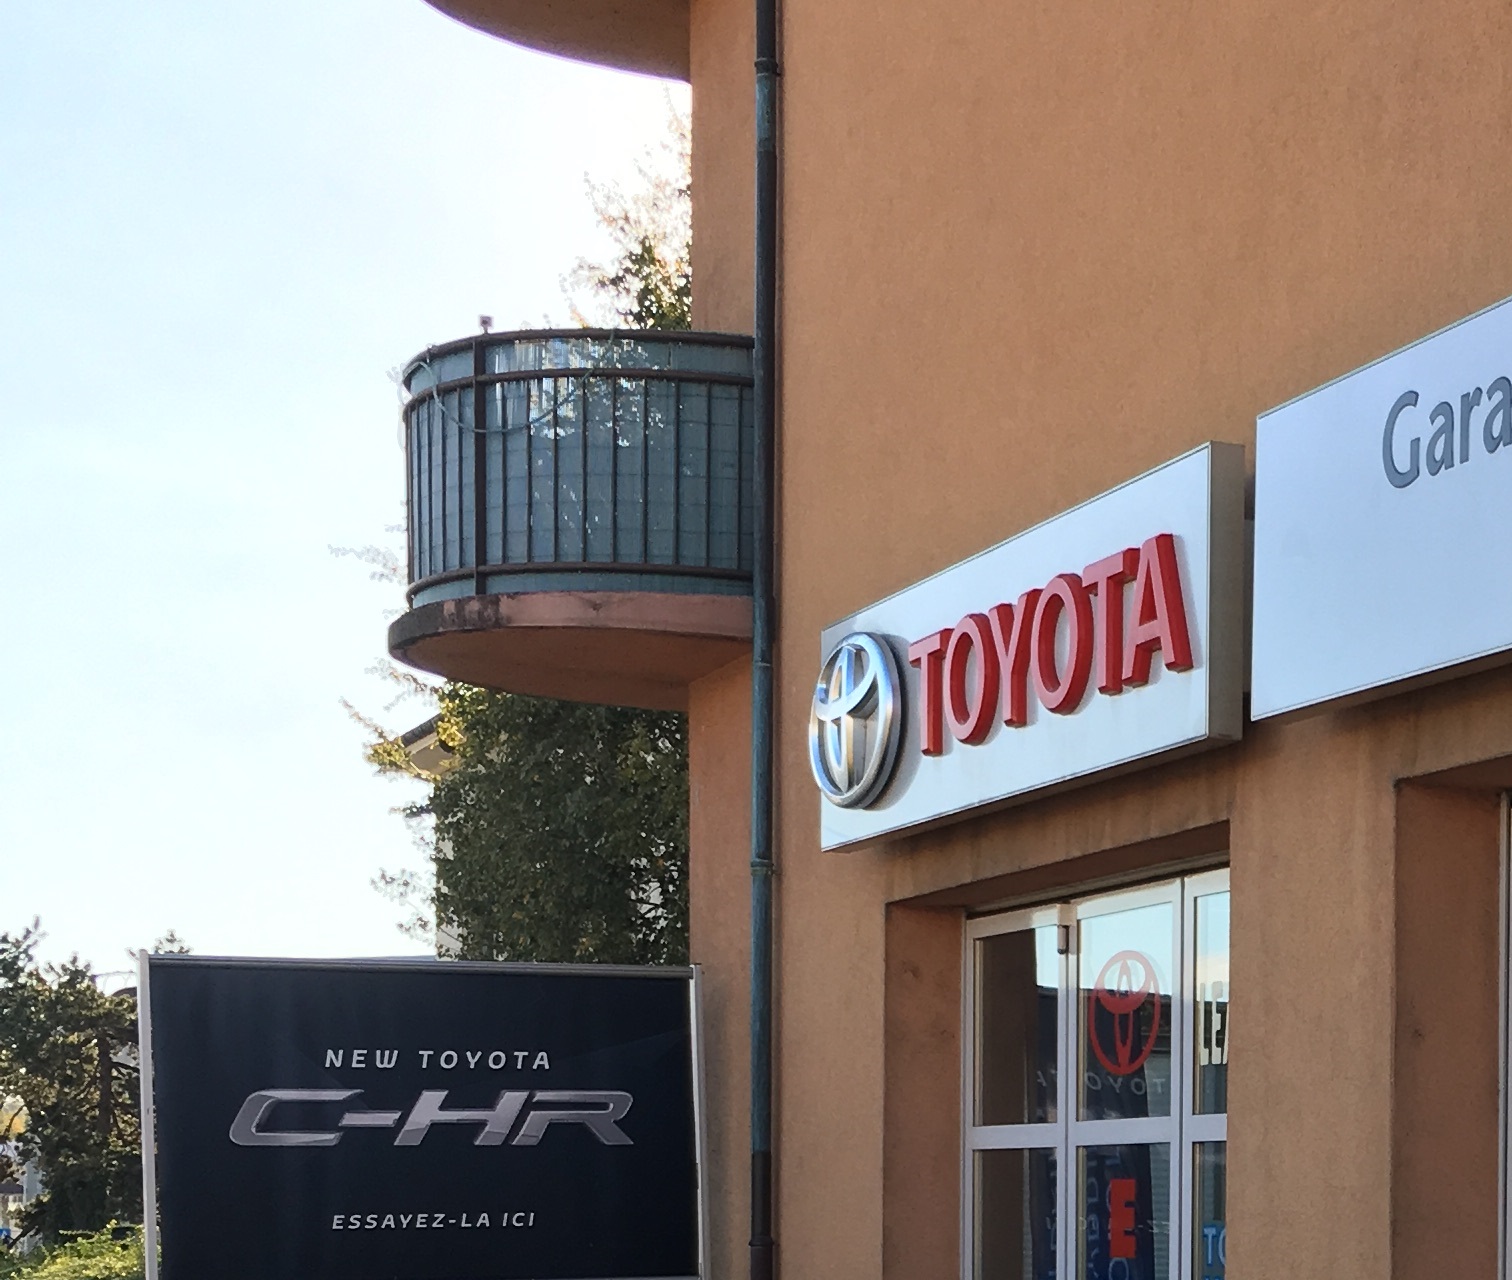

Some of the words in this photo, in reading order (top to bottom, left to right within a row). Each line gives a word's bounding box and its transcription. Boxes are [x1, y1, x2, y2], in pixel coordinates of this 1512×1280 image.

[908, 533, 1194, 757] TOYOTA
[325, 1048, 399, 1068] NEW
[418, 1050, 551, 1070] TOYOTA
[229, 1088, 634, 1147] C-HR
[331, 1212, 491, 1229] ESSAYEZ-LA
[502, 1211, 535, 1228] ICI
